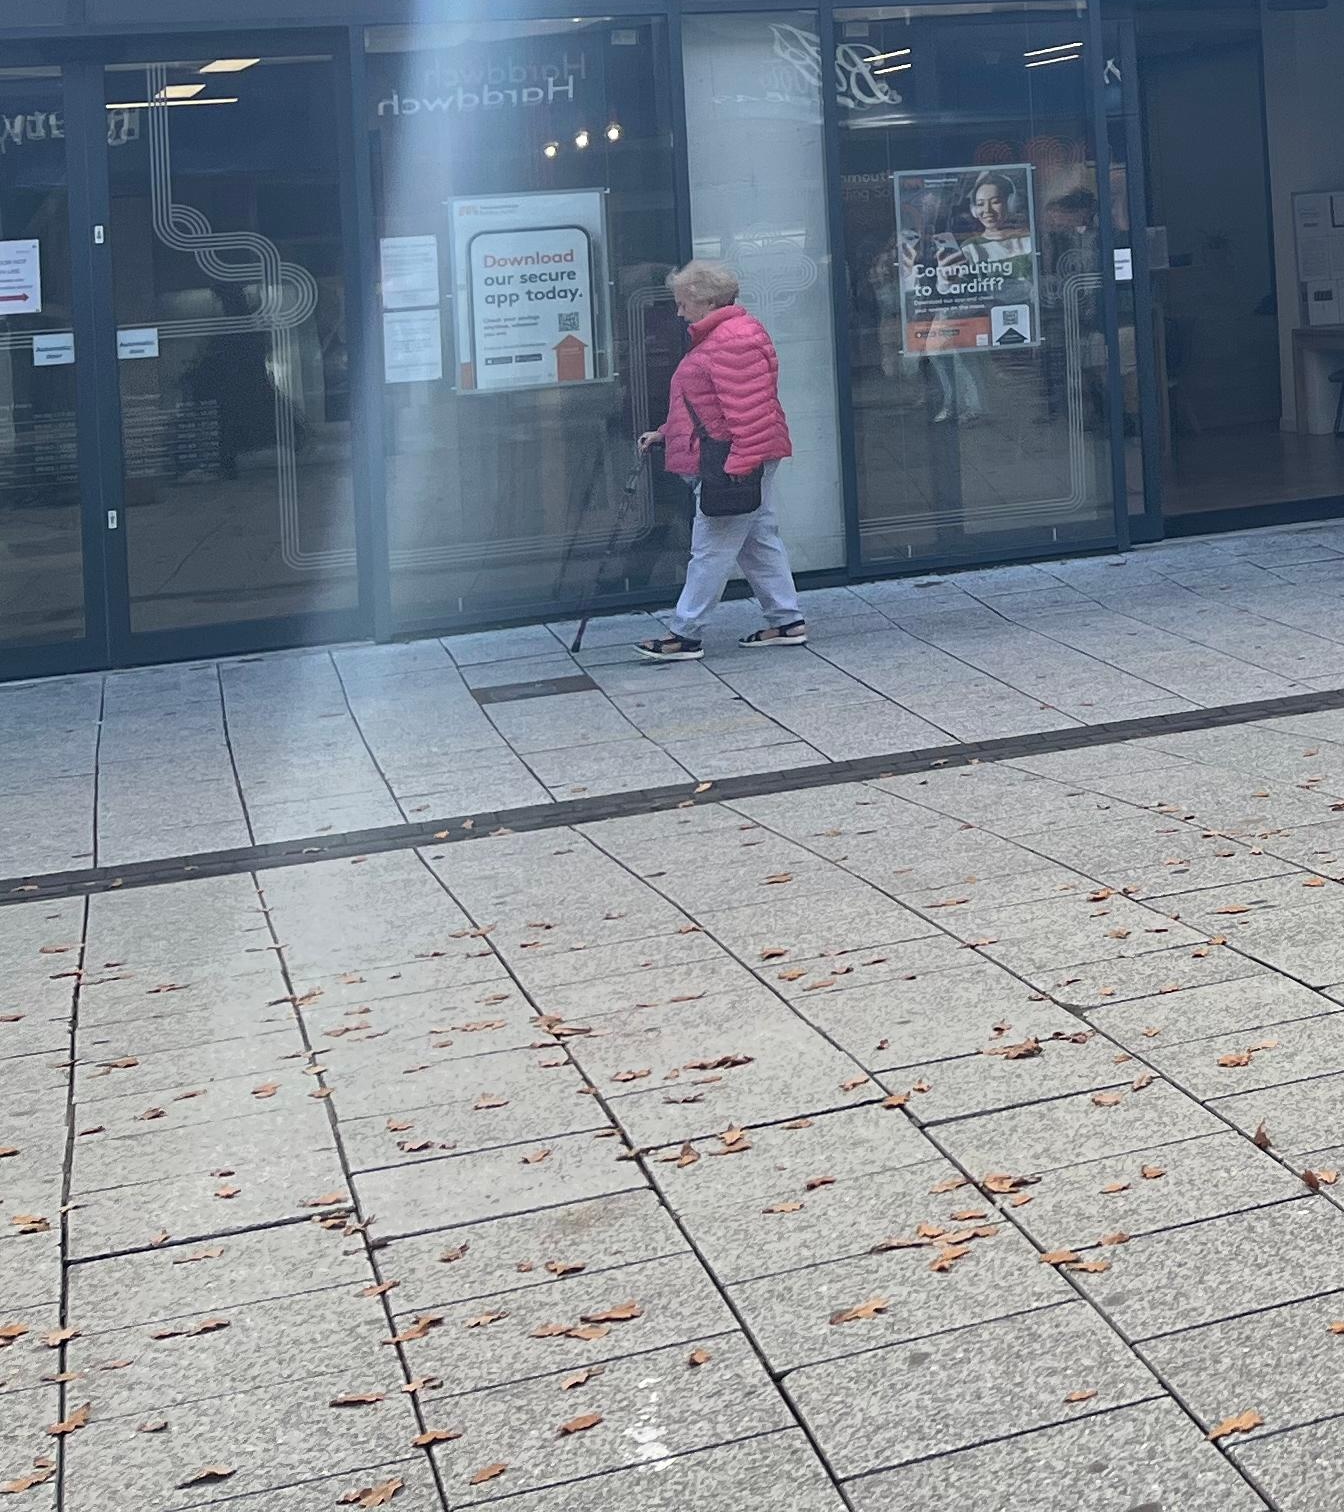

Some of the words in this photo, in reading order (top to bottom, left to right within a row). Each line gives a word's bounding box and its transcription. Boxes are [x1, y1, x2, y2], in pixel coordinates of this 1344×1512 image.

[484, 249, 574, 268] Download
[484, 273, 514, 286] our
[519, 270, 576, 284] secure
[913, 261, 1013, 279] Commuting
[914, 284, 932, 297] to
[936, 277, 1005, 295] Cardiff?
[485, 292, 519, 308] app
[525, 286, 583, 302] today.
